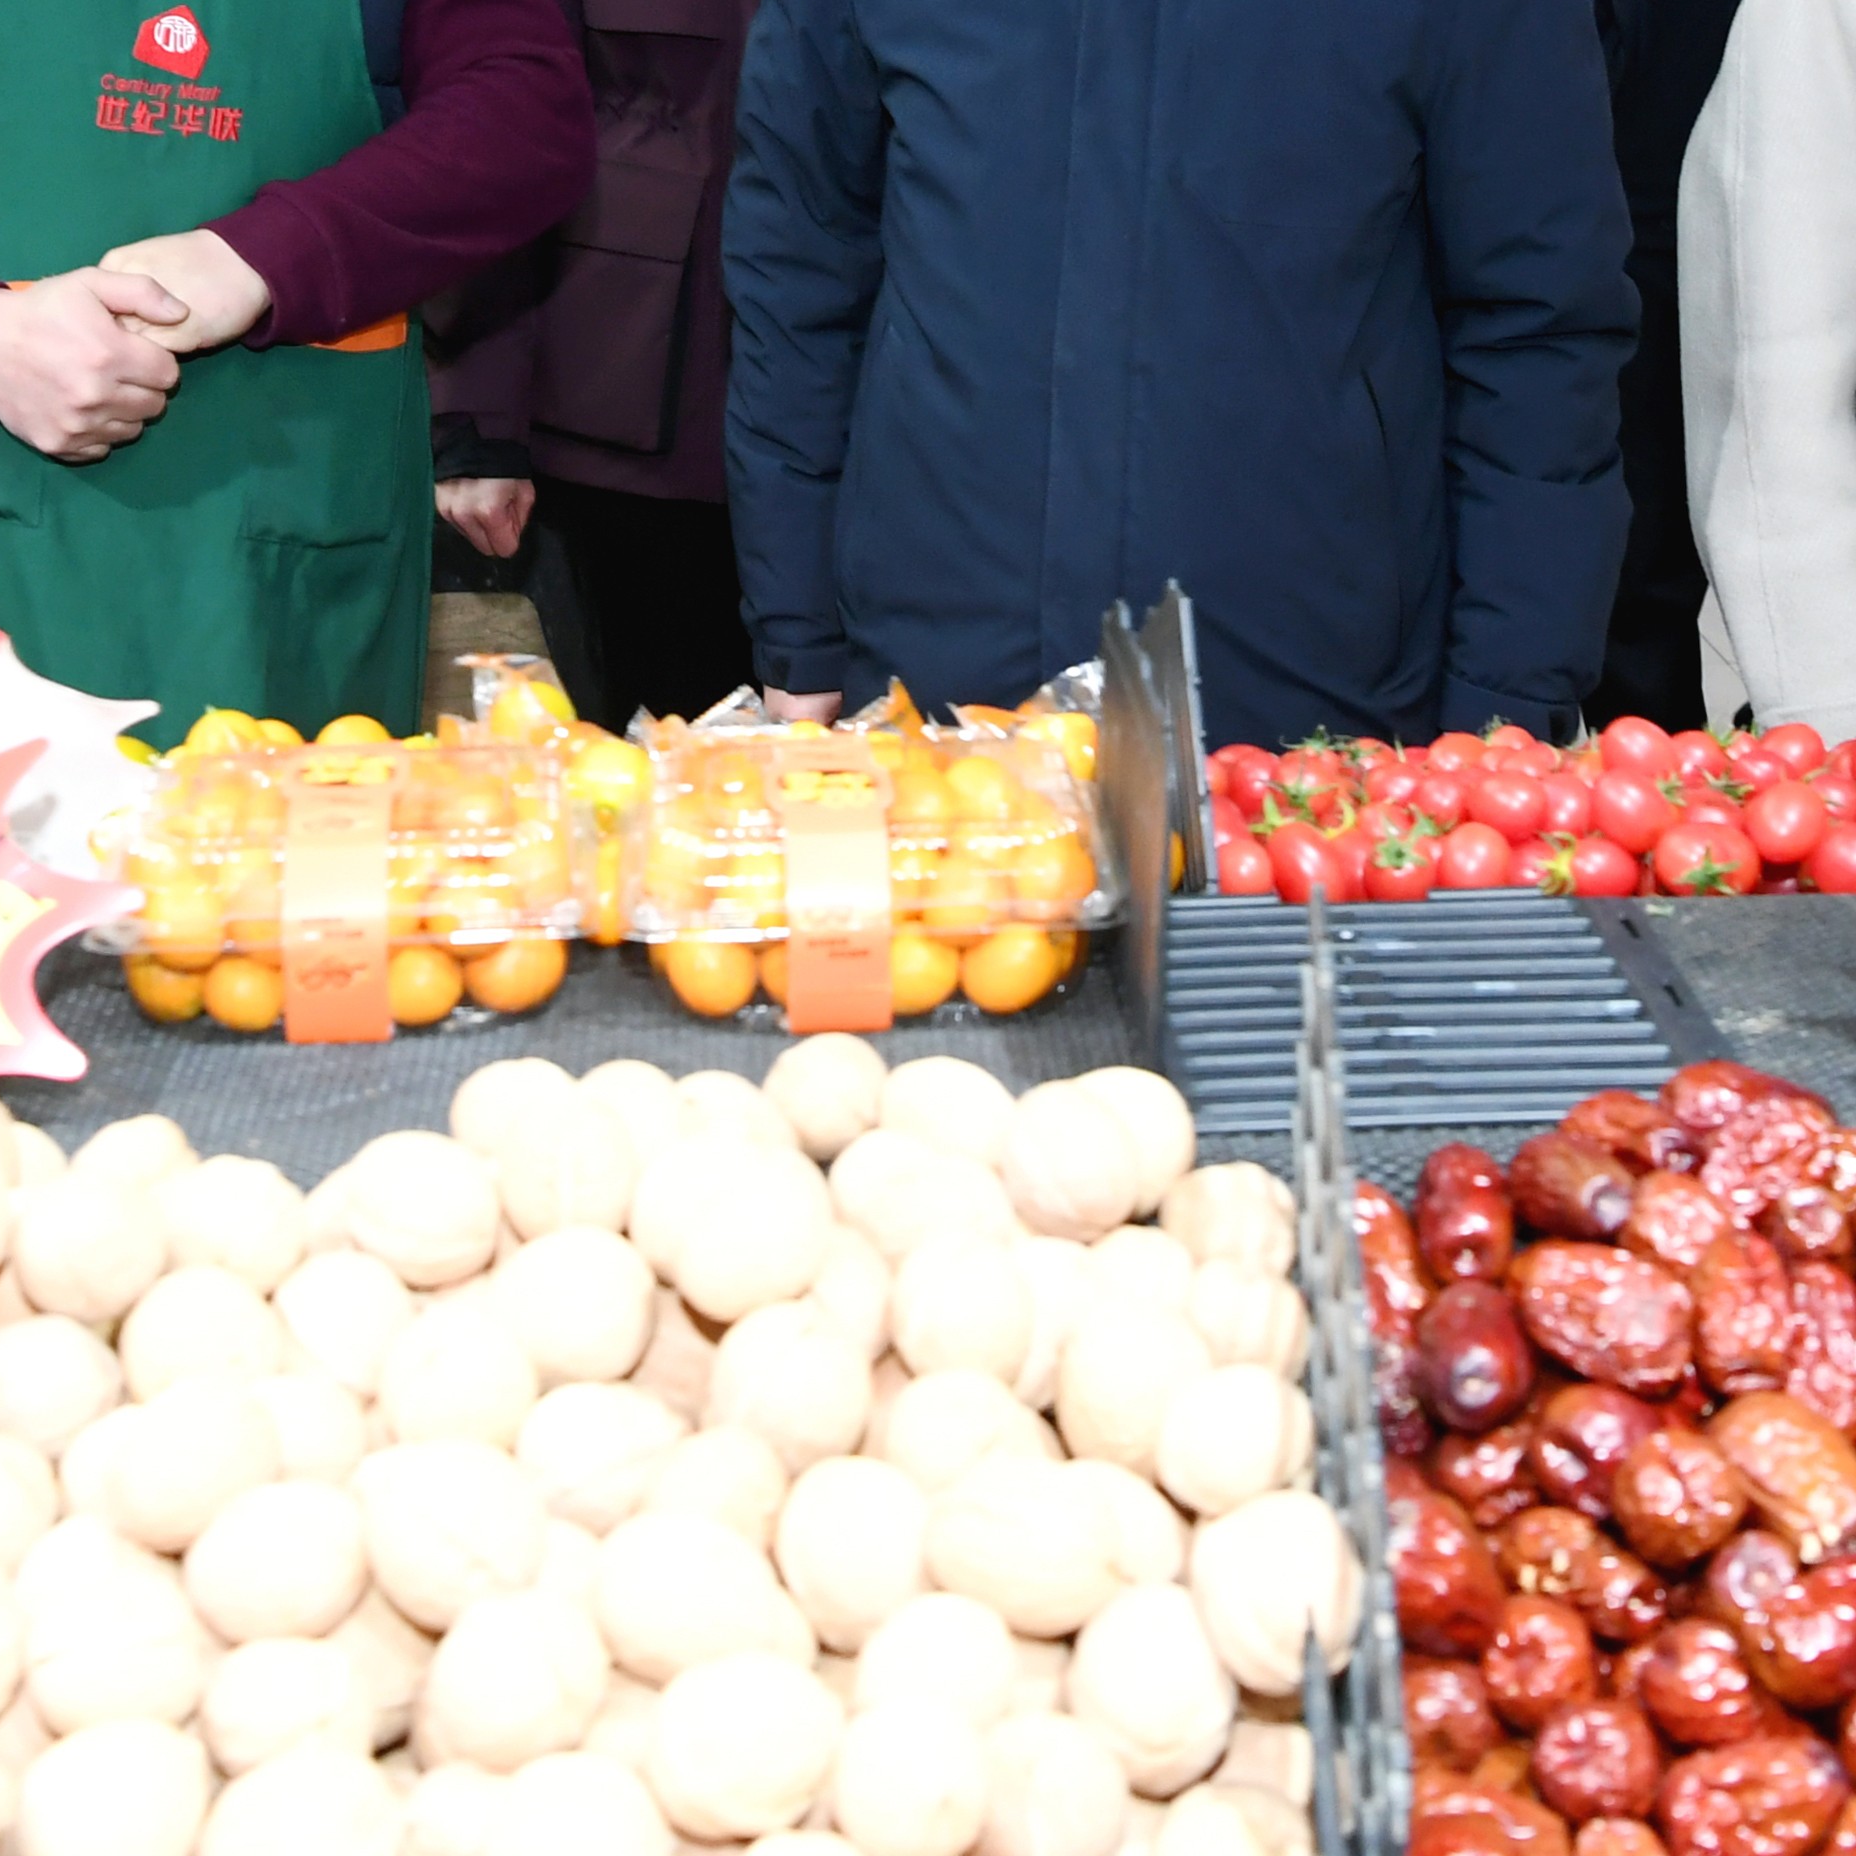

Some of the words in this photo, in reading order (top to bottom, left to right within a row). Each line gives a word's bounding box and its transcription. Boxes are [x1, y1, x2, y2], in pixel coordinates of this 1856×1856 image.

[100, 73, 172, 101] Century
[178, 84, 221, 101] Mart
[95, 94, 243, 142] 世纪华联
